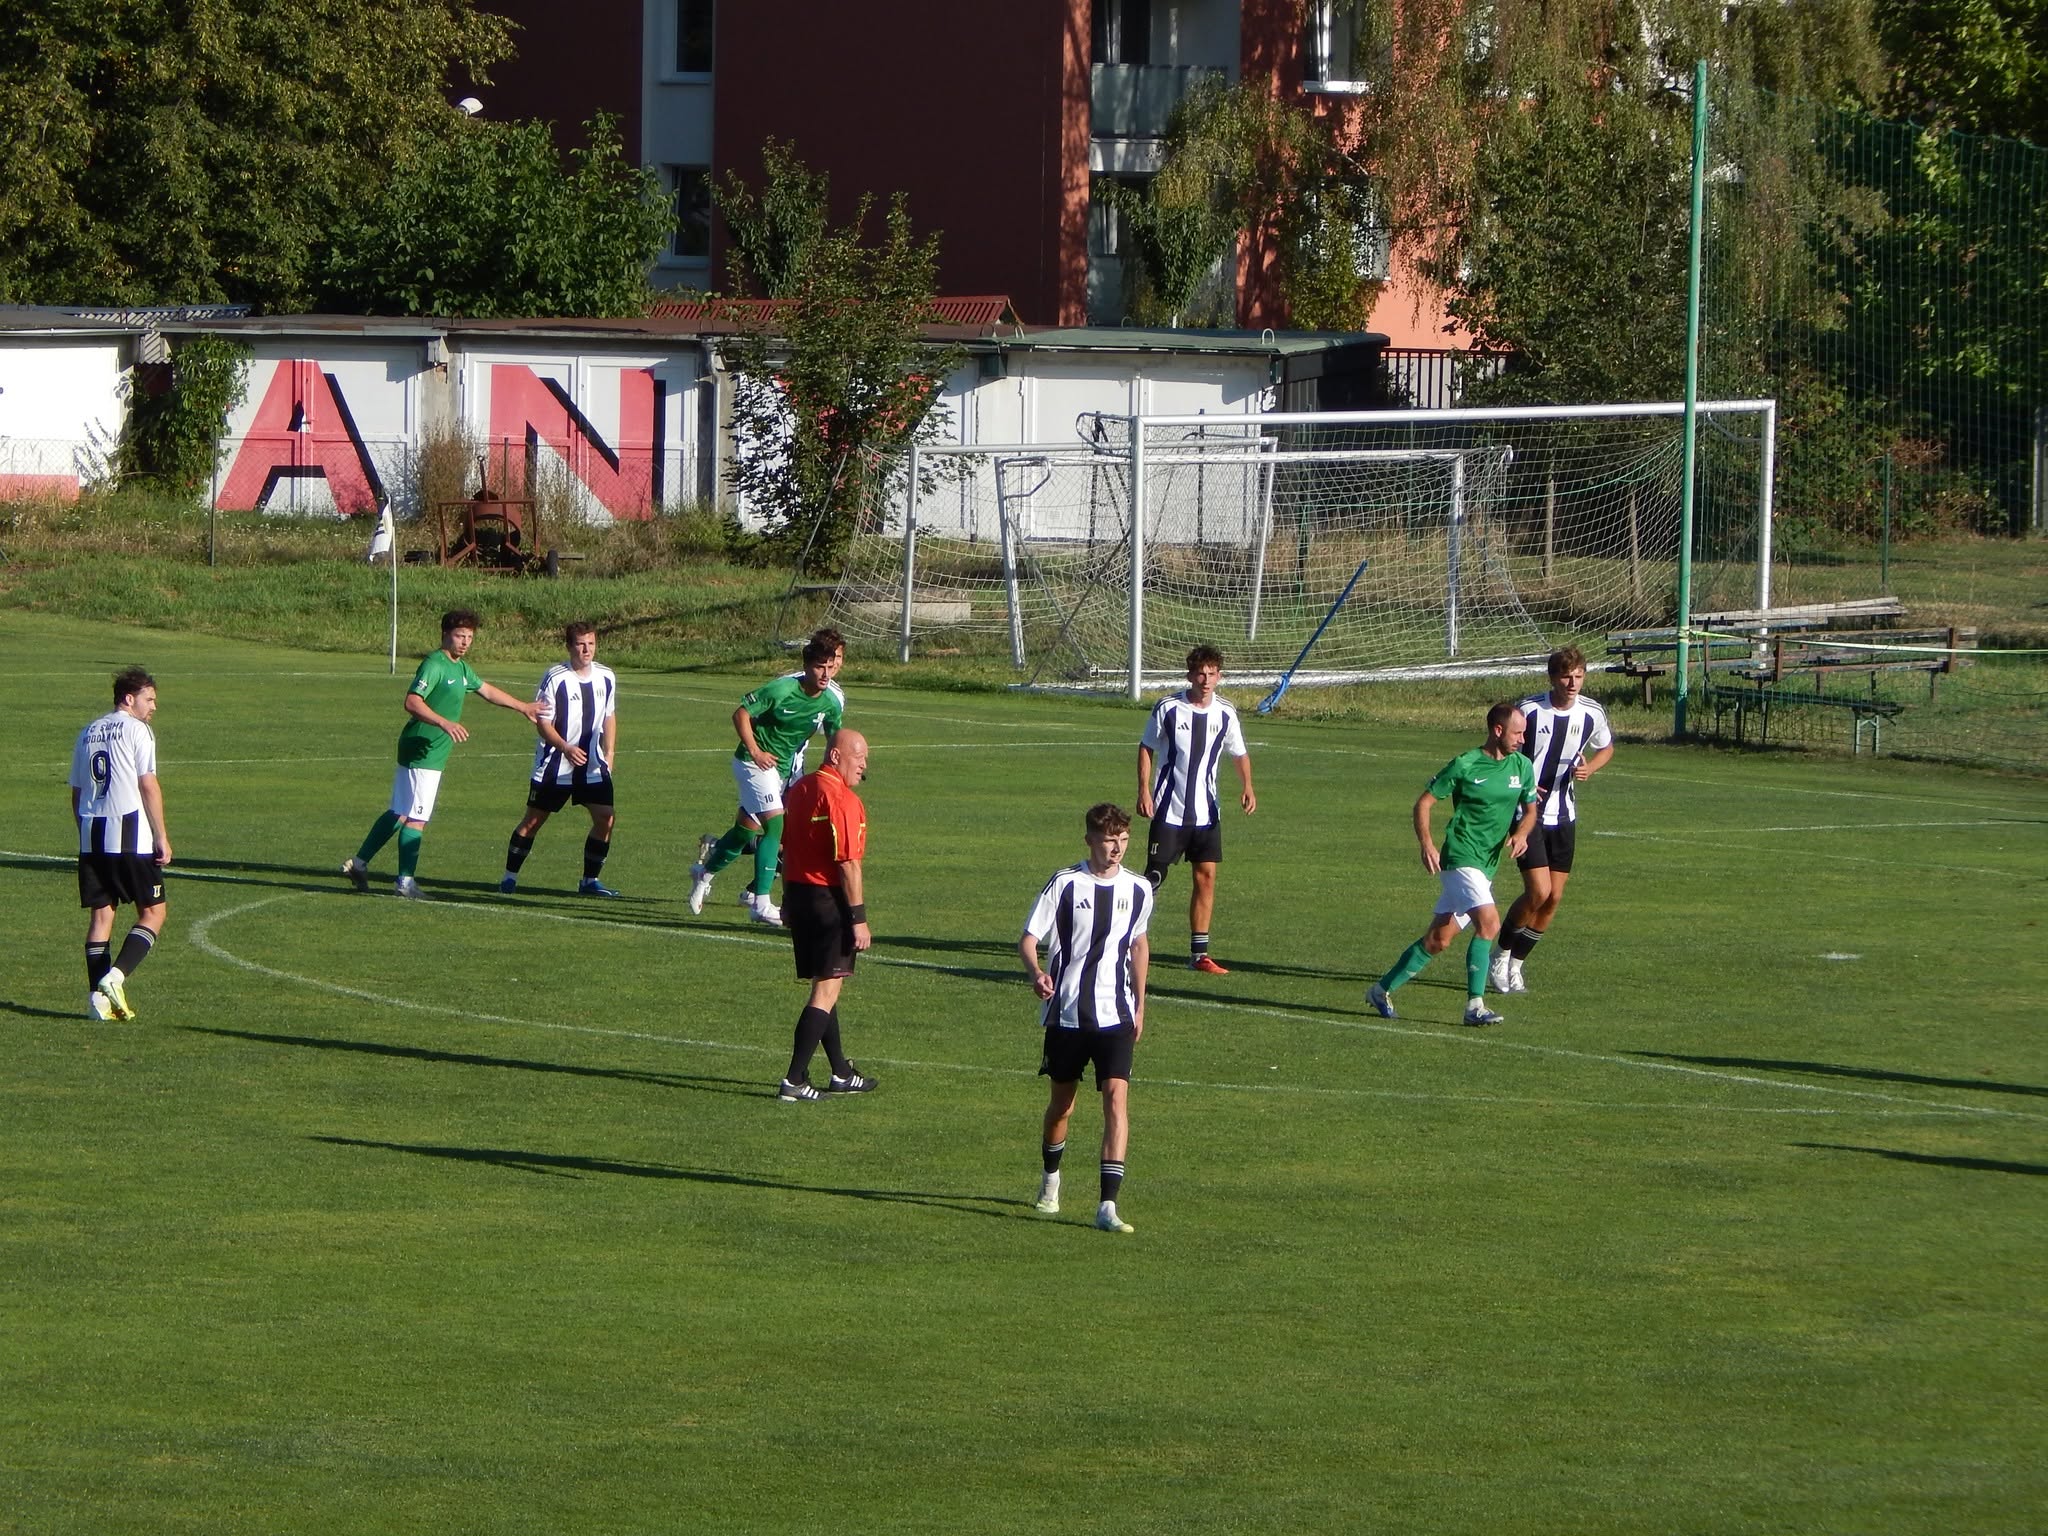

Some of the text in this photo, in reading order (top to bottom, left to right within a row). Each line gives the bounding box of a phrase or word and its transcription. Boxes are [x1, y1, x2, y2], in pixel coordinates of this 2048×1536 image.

[89, 750, 112, 800] 9
[764, 793, 774, 804] 10
[417, 805, 424, 815] 3
